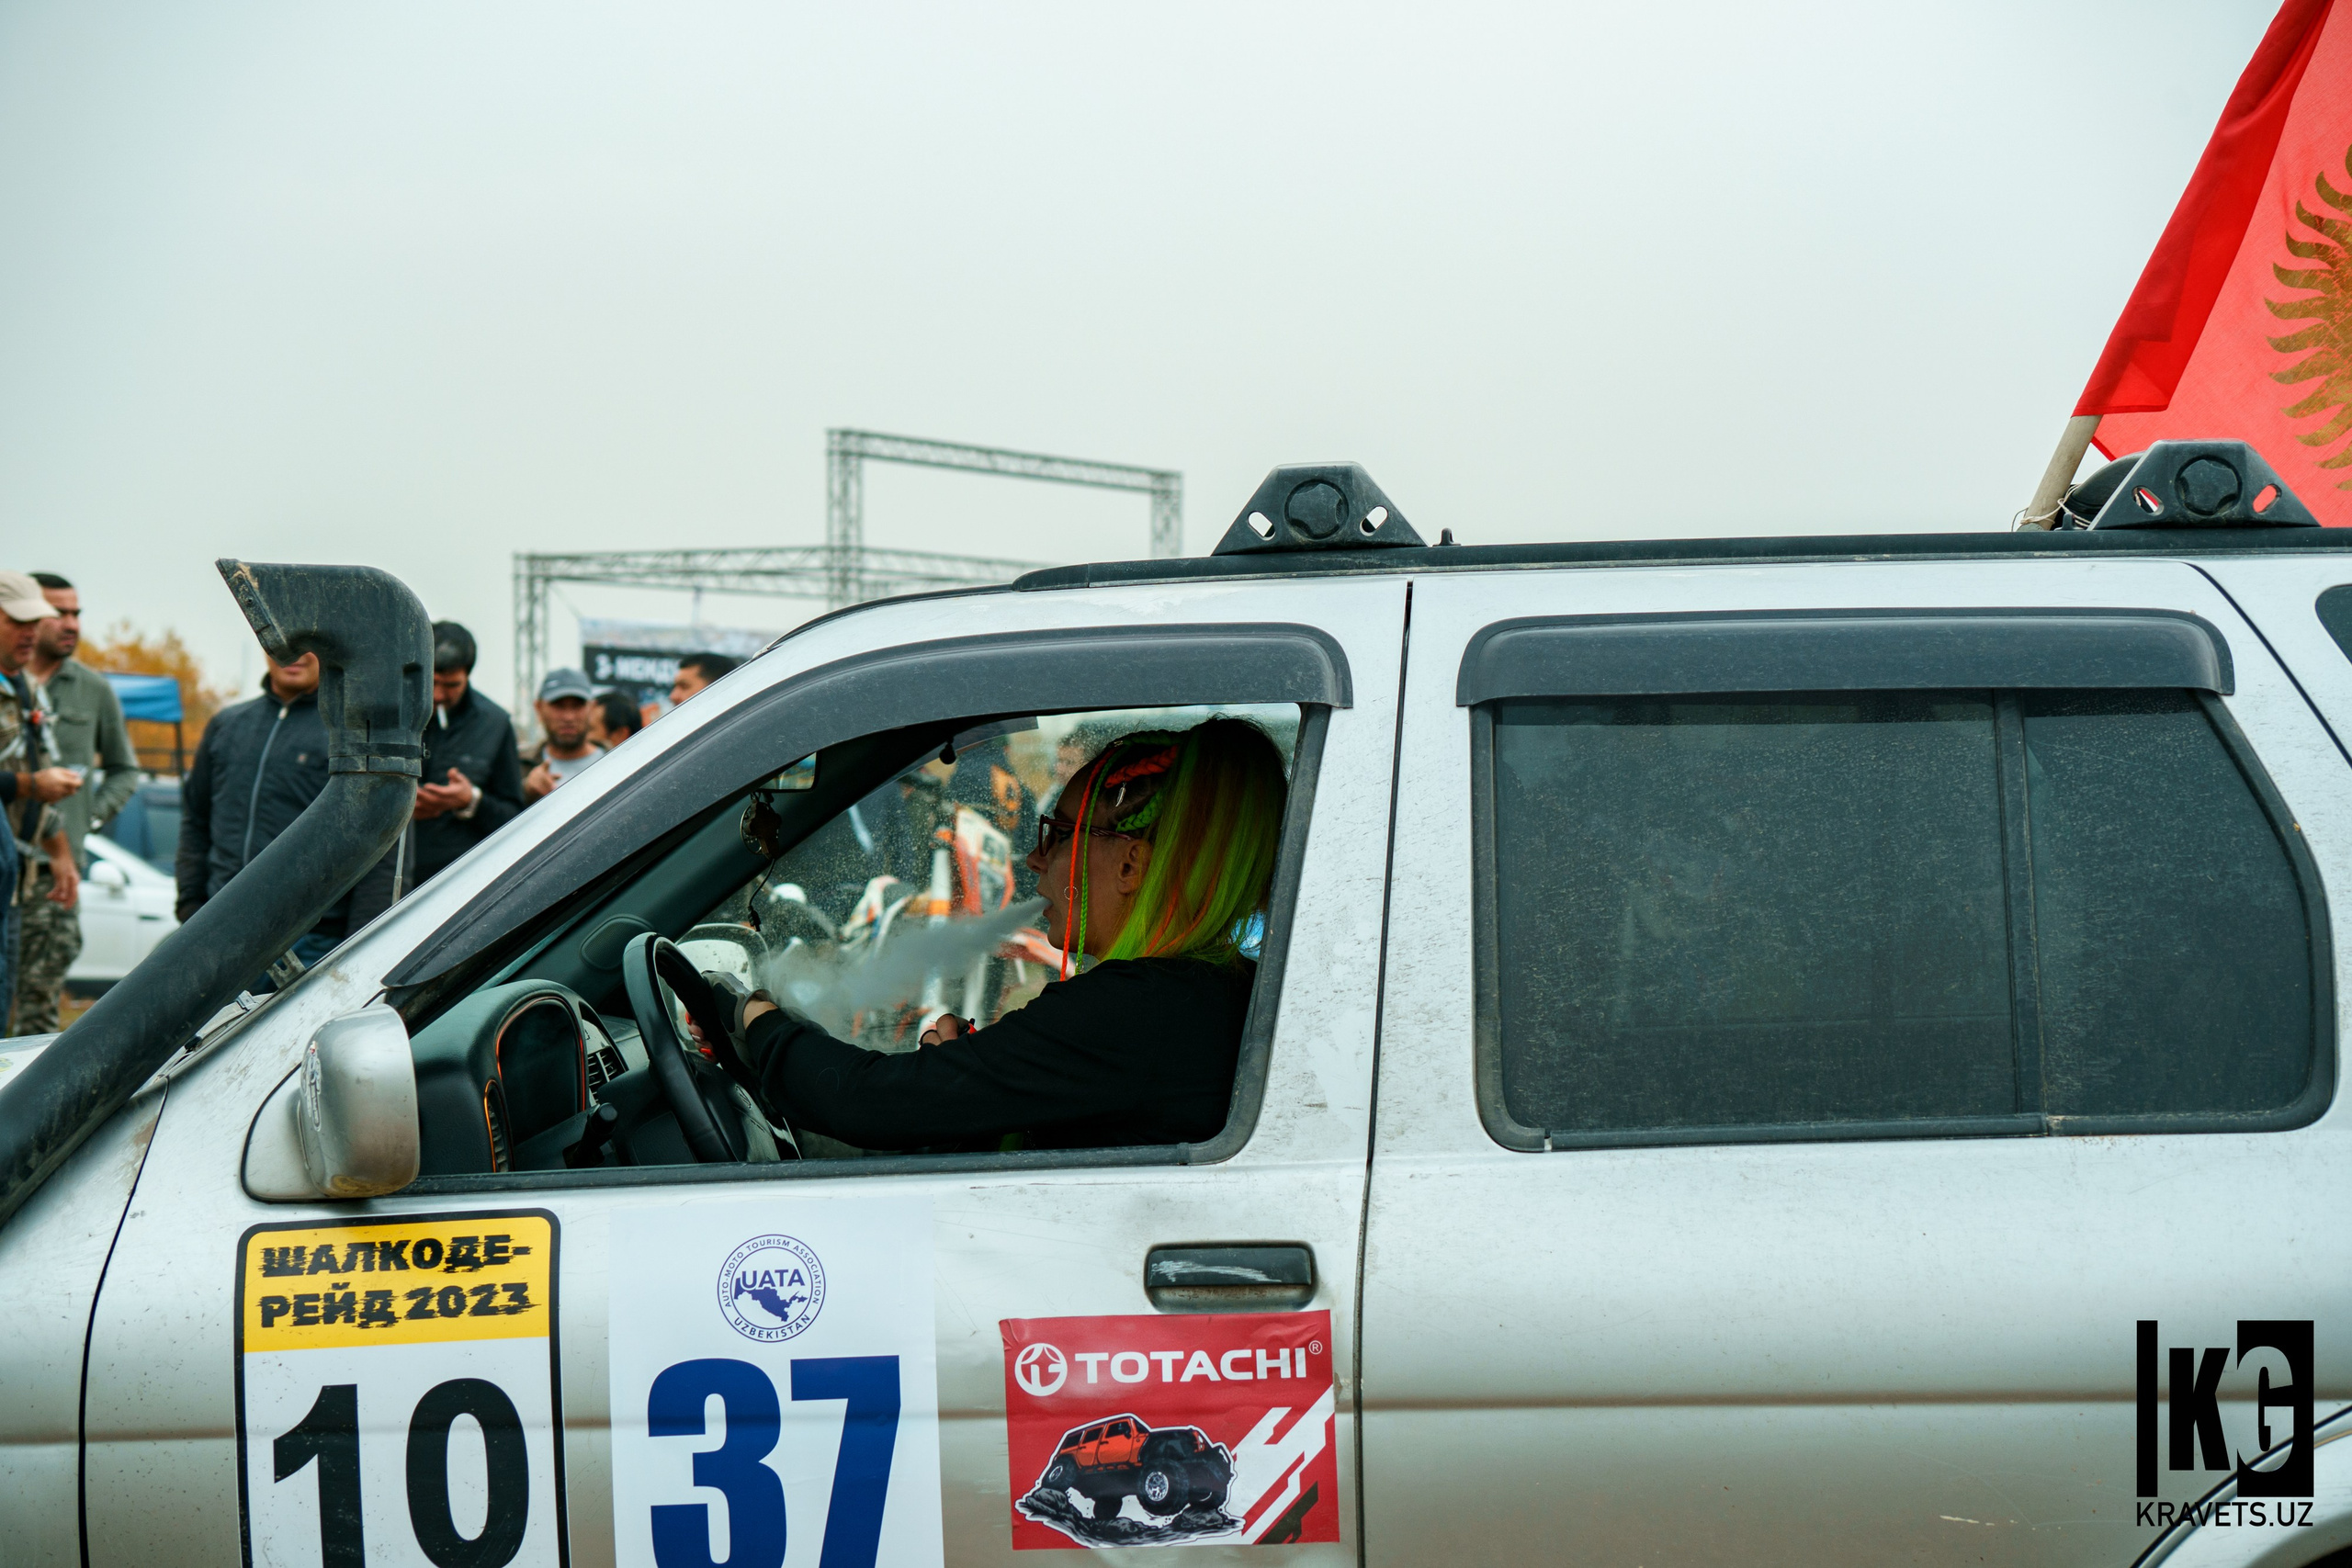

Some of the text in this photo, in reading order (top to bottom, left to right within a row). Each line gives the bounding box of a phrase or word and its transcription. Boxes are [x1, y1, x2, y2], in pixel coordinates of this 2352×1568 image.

[258, 1235, 535, 1278] ШАЛКОДЕ-
[722, 1238, 821, 1308] AUTO-MOTO TOURISM ASSOCIATION
[741, 1269, 805, 1289] UATA
[256, 1282, 540, 1329] РЕЙД 2023
[734, 1314, 810, 1339] UZBEKISTAN
[273, 1378, 530, 1568] 10
[648, 1355, 901, 1568] 37
